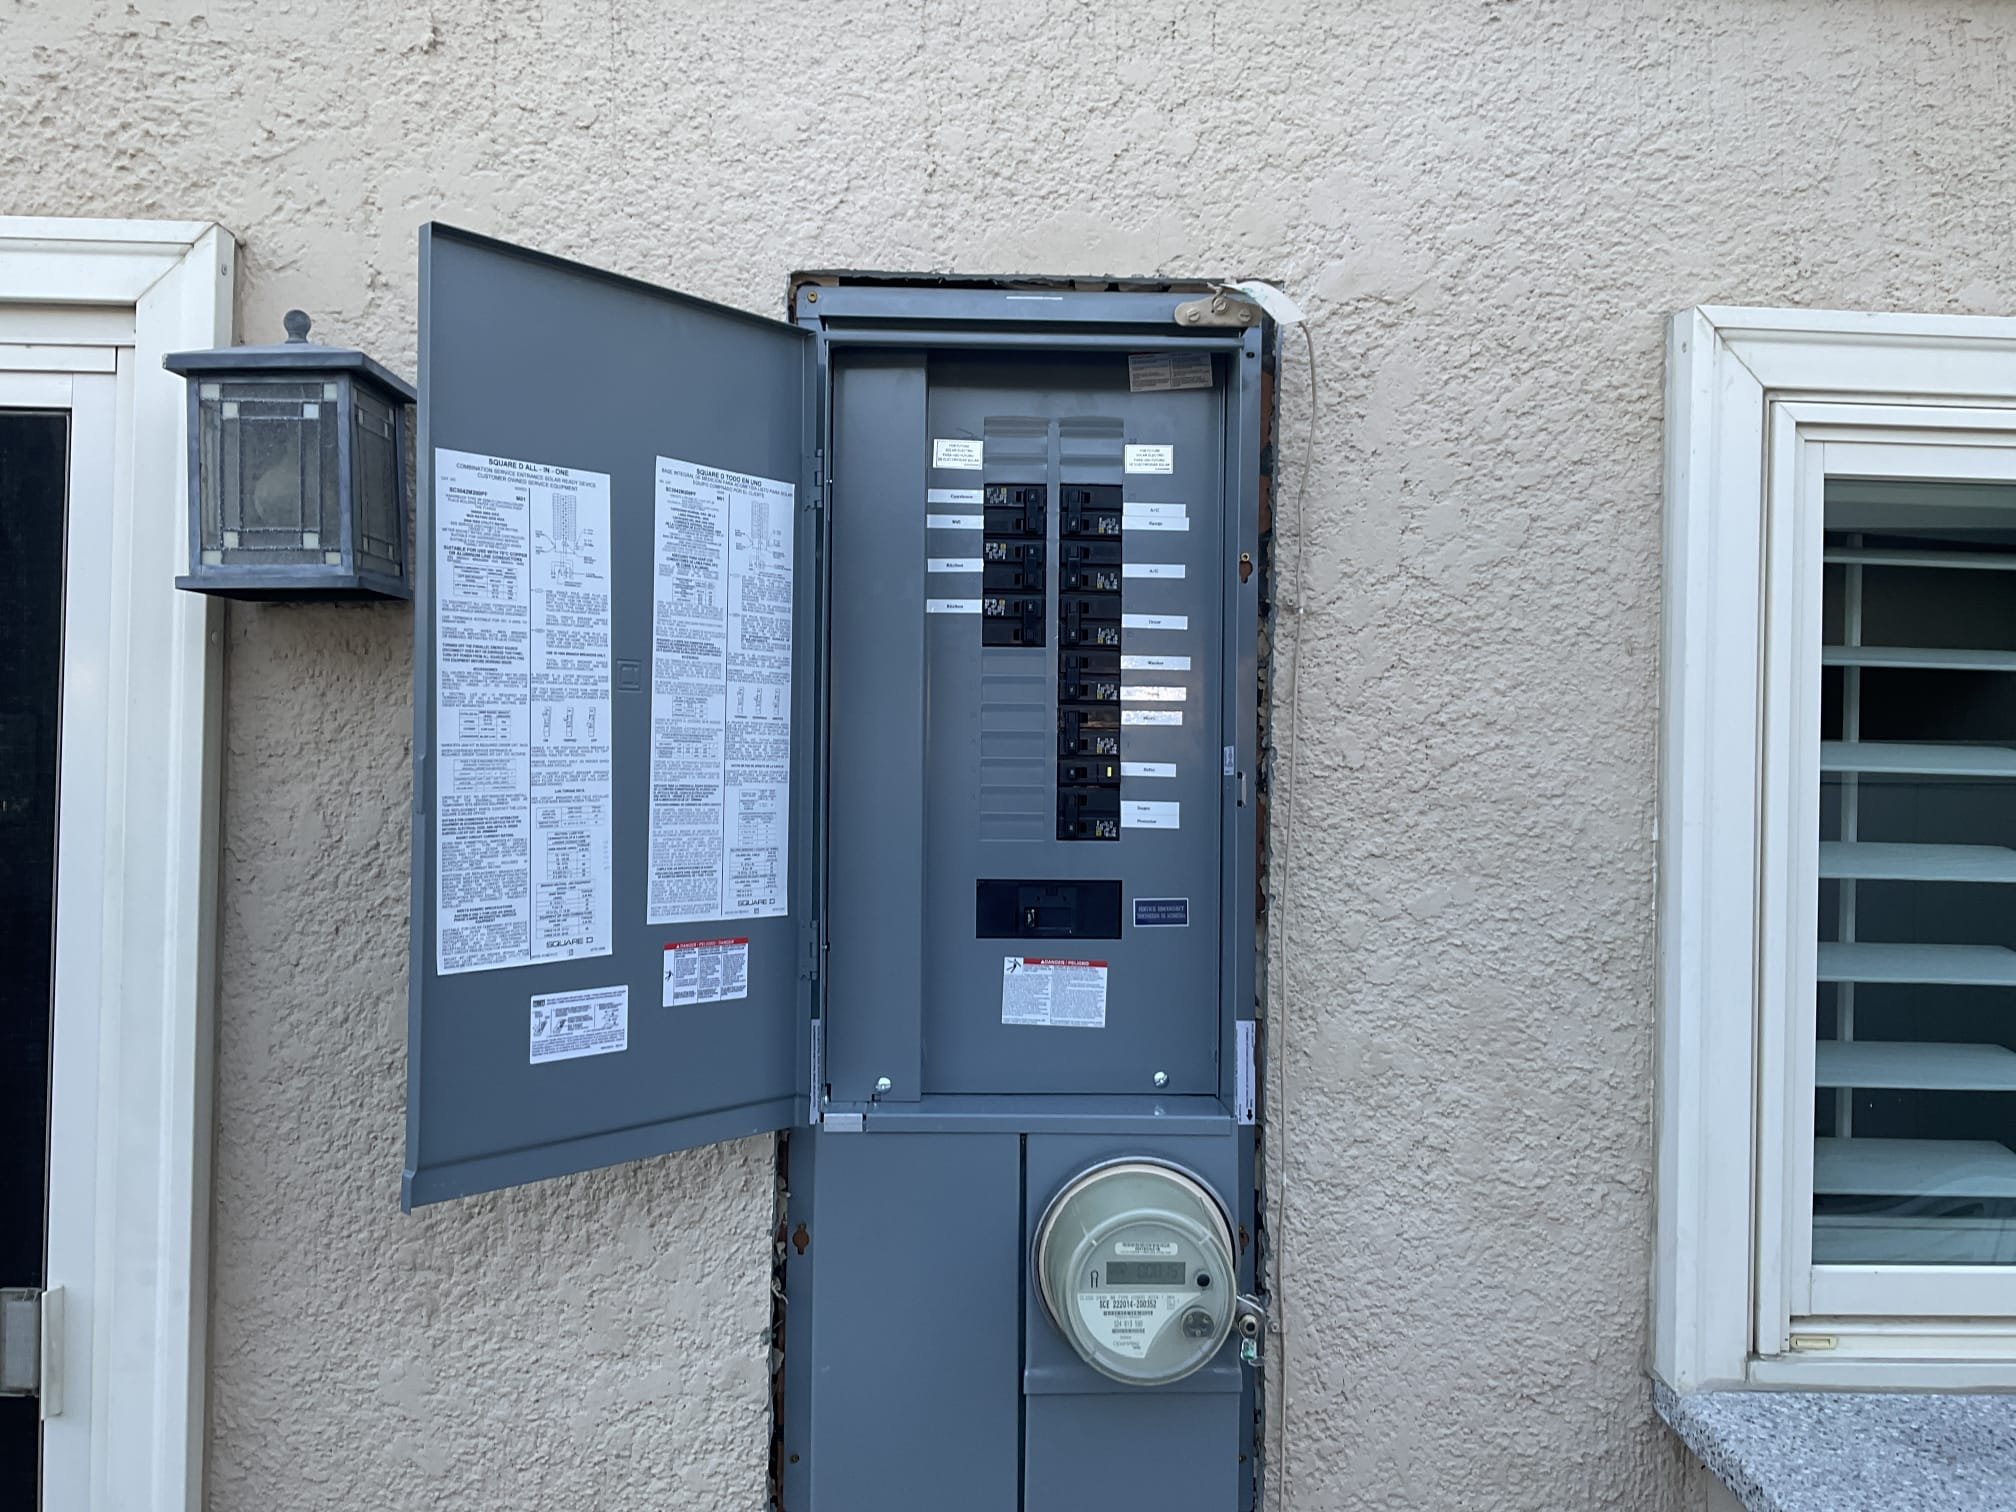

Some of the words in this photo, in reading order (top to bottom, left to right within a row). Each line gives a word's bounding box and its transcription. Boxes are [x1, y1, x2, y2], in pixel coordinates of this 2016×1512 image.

[456, 463, 493, 474] COMBINATION
[494, 469, 515, 478] SERVICE
[516, 471, 543, 481] ENTRANCE
[544, 474, 561, 483] SOLAR
[579, 478, 596, 488] DEVICE
[489, 458, 517, 470] SQUARE
[525, 464, 538, 473] ALL
[543, 465, 550, 473] IN
[555, 467, 569, 476] ONE
[477, 472, 506, 482] CUSTOMER
[528, 478, 549, 488] SERVICE
[549, 480, 578, 492] EQUIPMENT
[696, 468, 719, 479] SQUARE
[726, 474, 741, 483] TODO
[742, 477, 750, 485] EN
[750, 478, 762, 487] UNO
[737, 899, 768, 907] SQUARE
[546, 937, 584, 948] SQUARE
